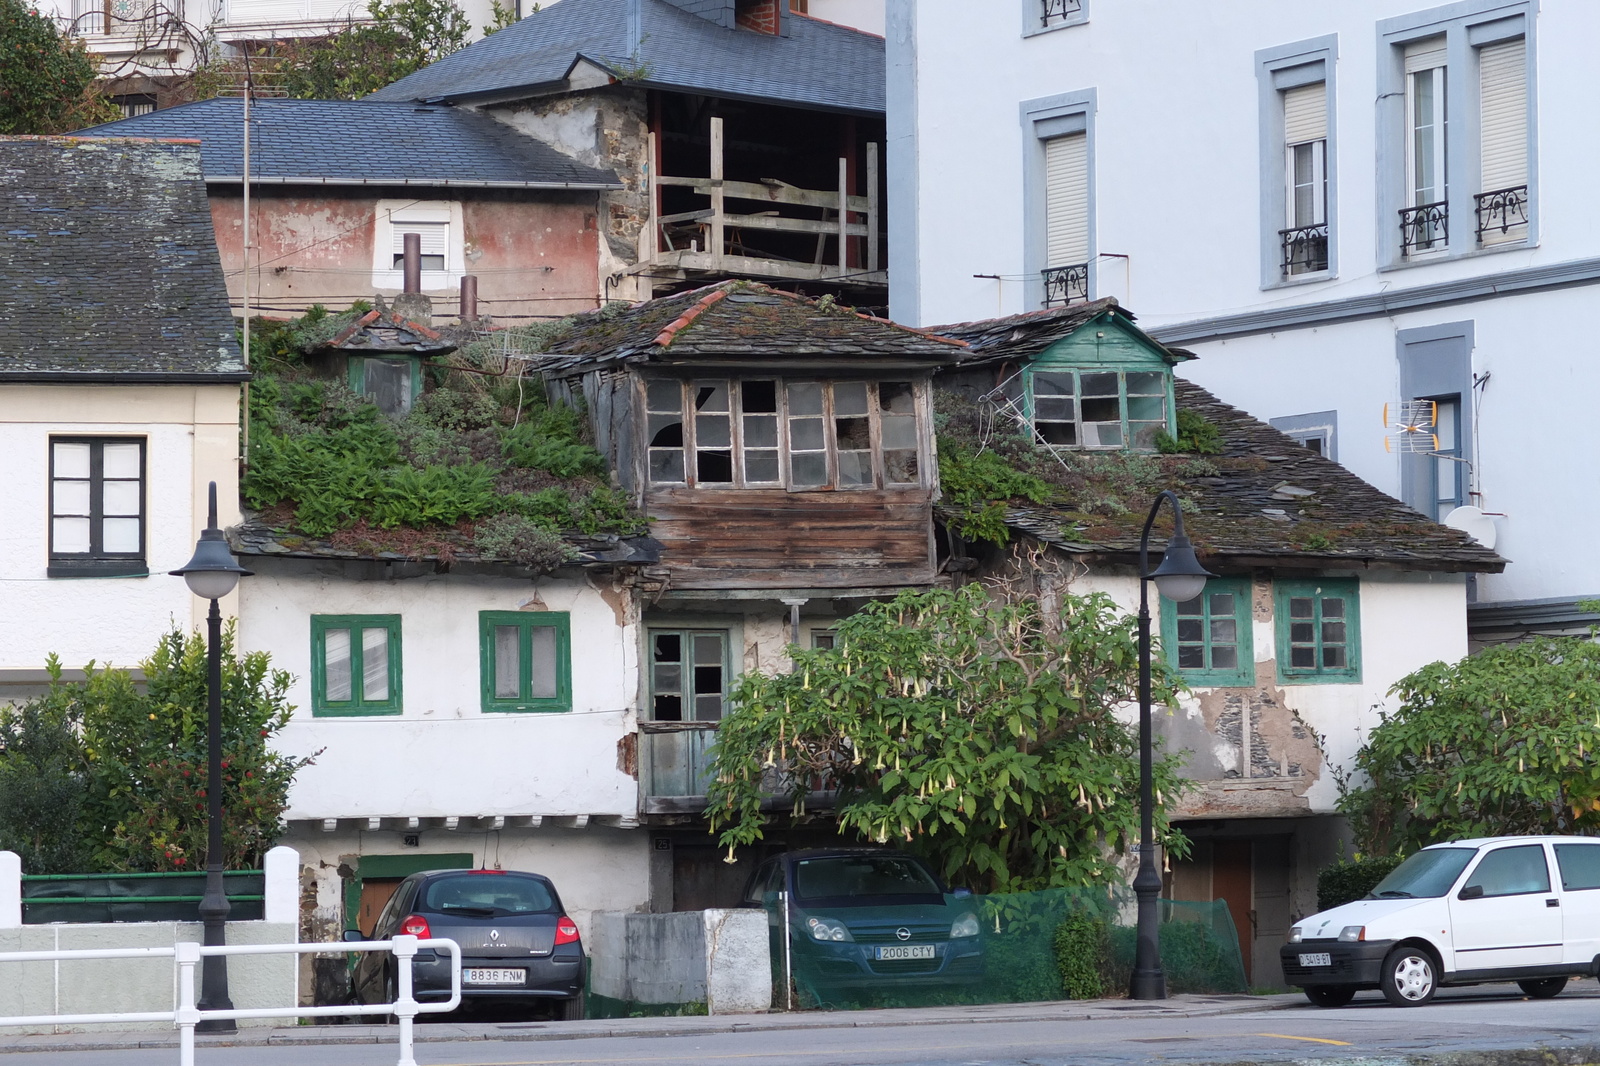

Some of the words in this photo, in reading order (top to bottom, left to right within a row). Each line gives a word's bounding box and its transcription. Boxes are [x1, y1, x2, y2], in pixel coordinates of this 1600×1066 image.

[658, 840, 668, 849] 25
[883, 947, 909, 959] 2006
[912, 946, 932, 957] CTY
[471, 970, 499, 981] 8836
[502, 970, 523, 981] FNM
